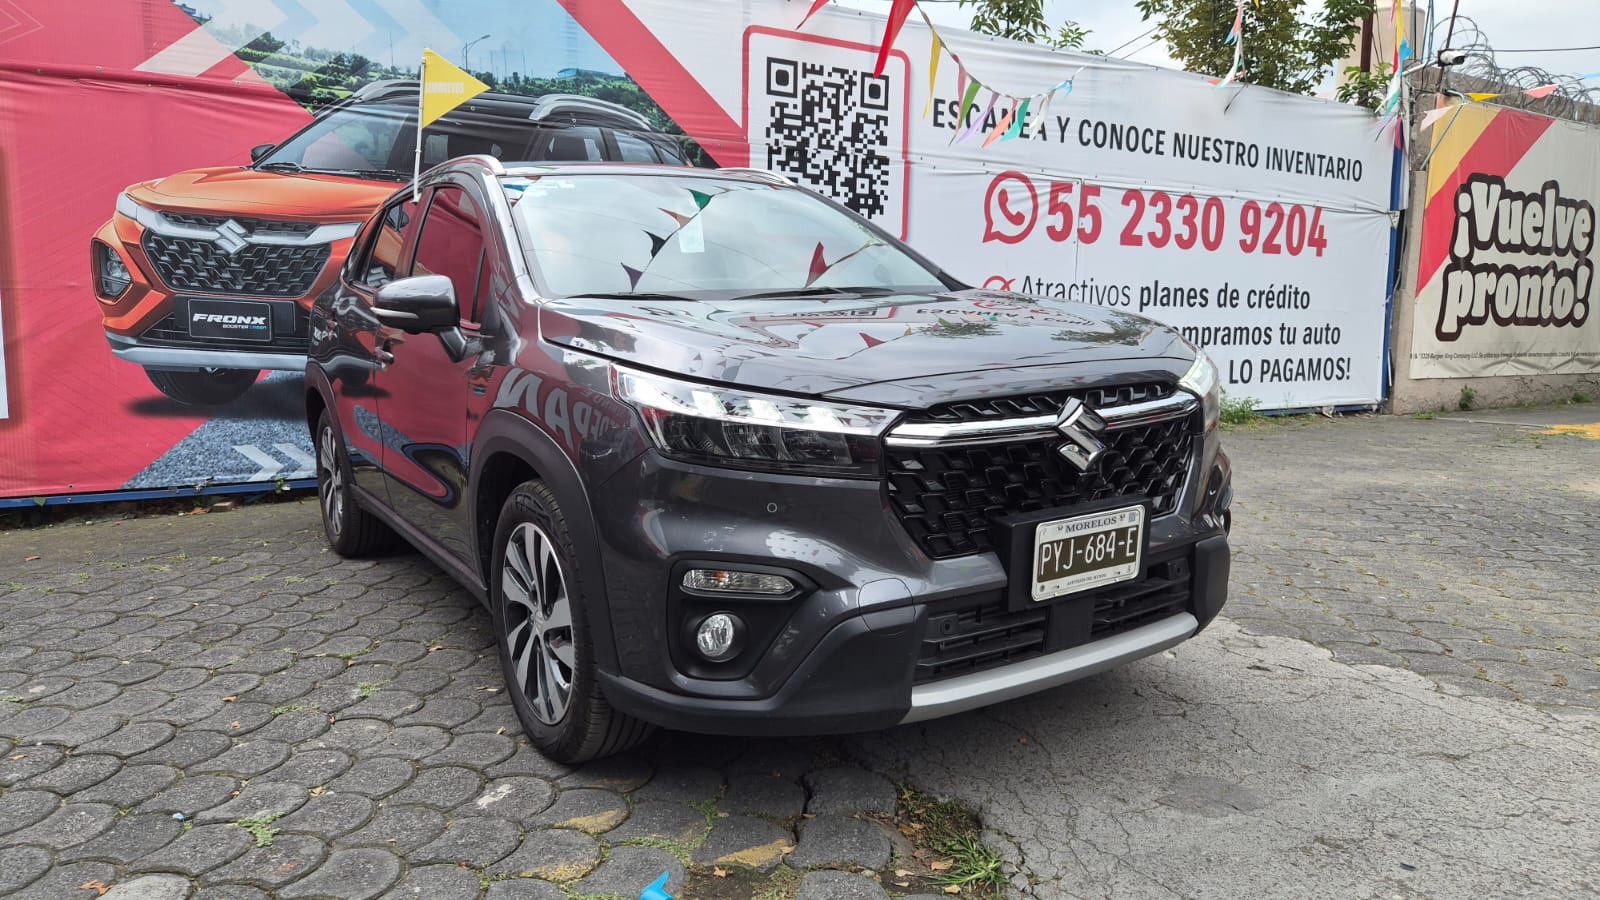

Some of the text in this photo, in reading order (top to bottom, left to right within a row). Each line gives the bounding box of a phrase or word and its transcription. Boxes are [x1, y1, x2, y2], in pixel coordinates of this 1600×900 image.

[1056, 116, 1071, 143] Y
[1078, 119, 1165, 155] CONOCE
[1173, 132, 1259, 168] NUESTRO
[1266, 146, 1363, 182] INVENTARIO
[1046, 181, 1328, 257] 55 2330 9204
[1451, 174, 1594, 258] ¡Vuelve
[1022, 275, 1311, 312] Atractivos planes de crédito
[1437, 261, 1592, 338] pronto!
[192, 312, 267, 325] FRONX
[1279, 322, 1297, 344] tu
[1302, 322, 1341, 344] auto
[1229, 357, 1351, 384] LO PAGAMOS!
[1065, 515, 1117, 533] MORELOS
[1040, 527, 1138, 576] PYJ-684-E
